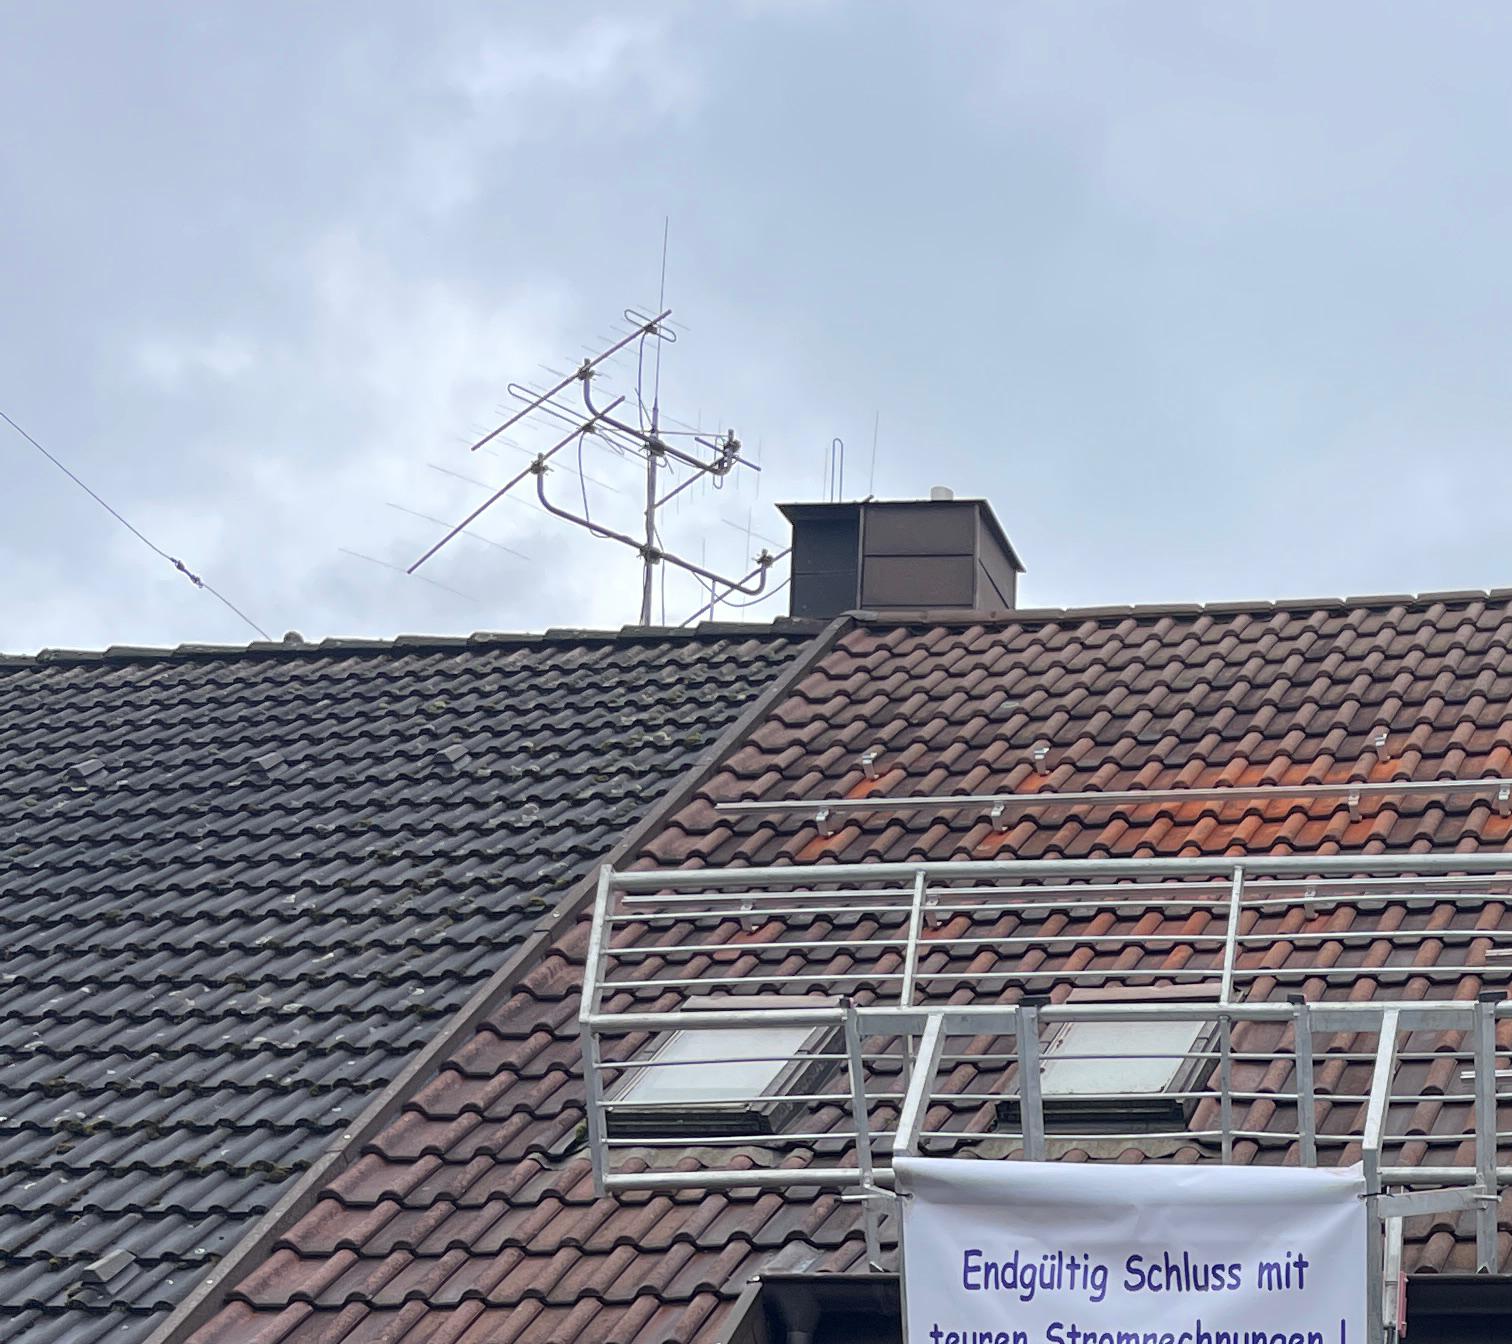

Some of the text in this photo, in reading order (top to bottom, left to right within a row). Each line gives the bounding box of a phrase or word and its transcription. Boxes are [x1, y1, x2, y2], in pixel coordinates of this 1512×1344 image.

[963, 1249, 1310, 1302] Endgültig Schluss mit
